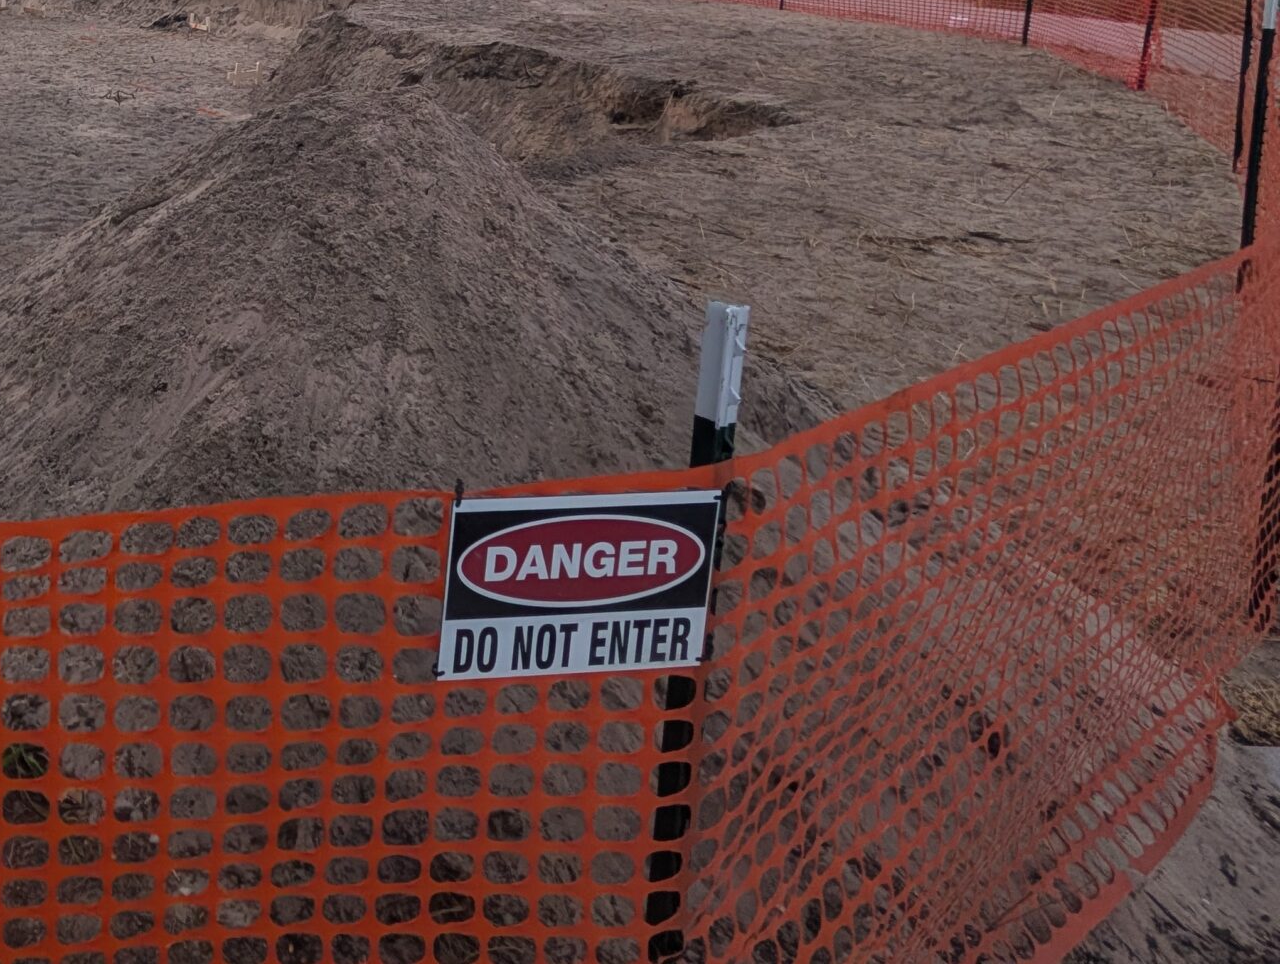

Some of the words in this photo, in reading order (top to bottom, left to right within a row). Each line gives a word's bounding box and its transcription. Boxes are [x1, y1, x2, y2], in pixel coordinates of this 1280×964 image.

[484, 539, 678, 582] DANGER
[453, 627, 498, 674] DO
[511, 623, 579, 671] NOT
[589, 617, 691, 668] ENTER
